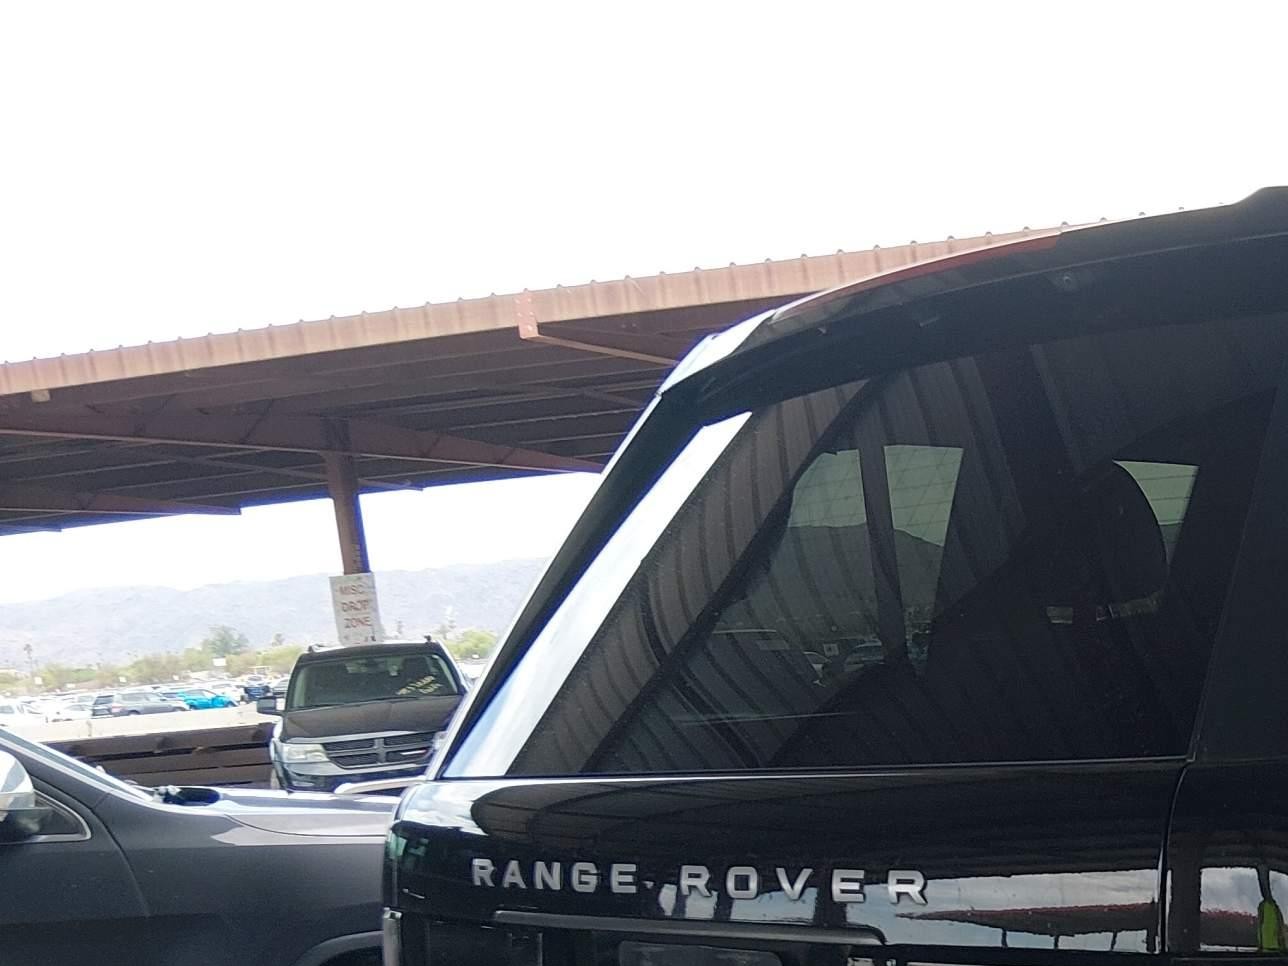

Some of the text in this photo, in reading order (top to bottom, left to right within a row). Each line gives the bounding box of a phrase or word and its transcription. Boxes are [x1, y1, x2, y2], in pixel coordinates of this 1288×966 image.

[341, 599, 370, 613] DROP
[343, 616, 373, 629] ZONE
[472, 857, 928, 905] RANGE ROVER
